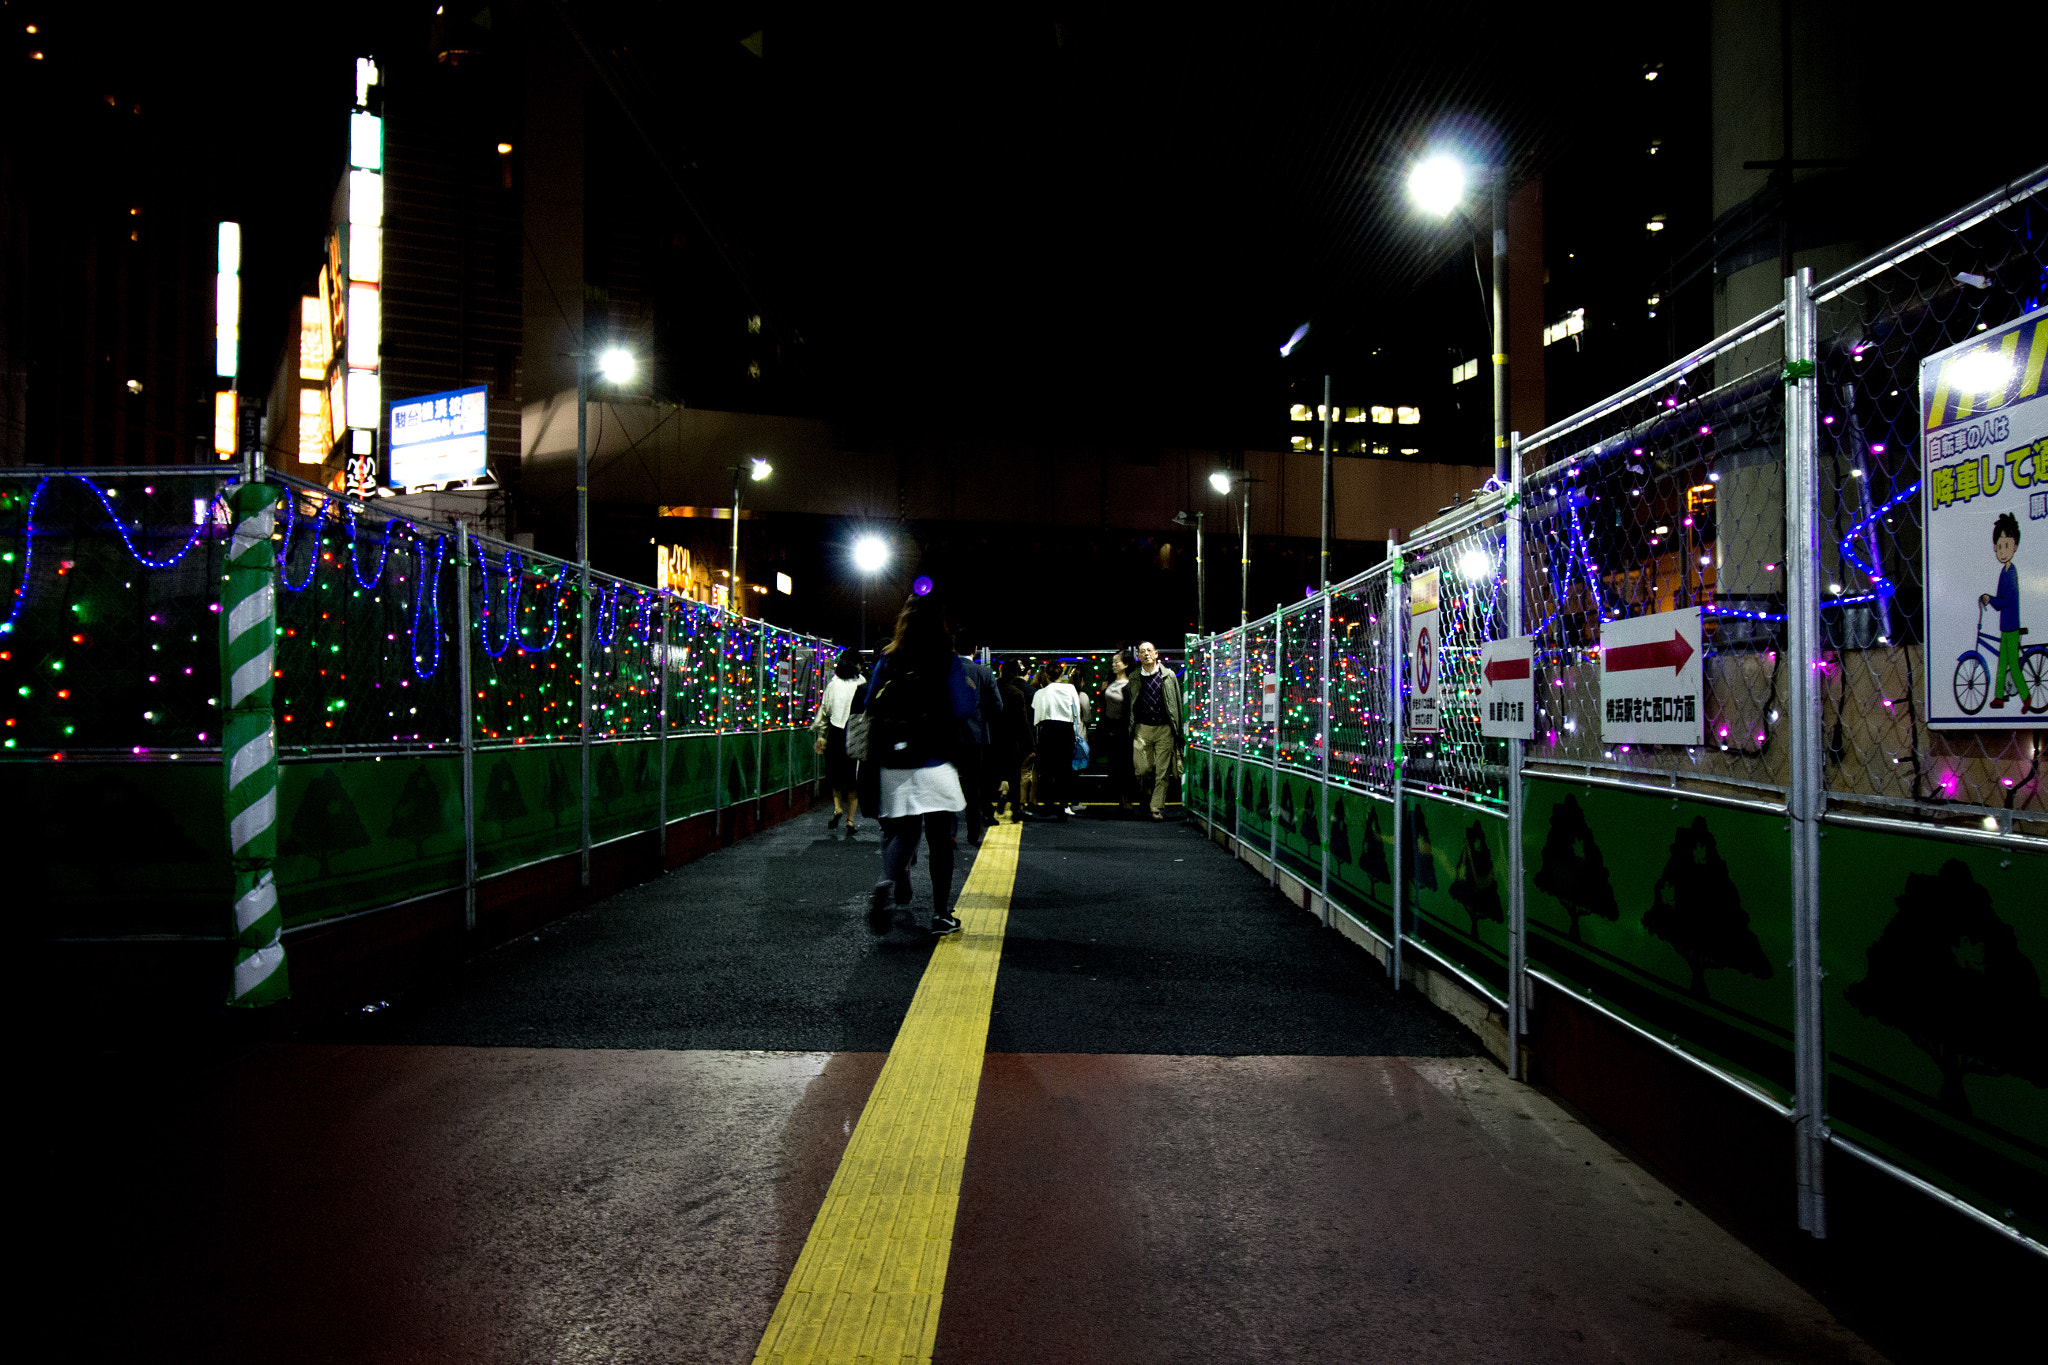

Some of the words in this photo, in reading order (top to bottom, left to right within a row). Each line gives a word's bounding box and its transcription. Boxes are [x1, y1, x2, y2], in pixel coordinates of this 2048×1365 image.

[1929, 416, 2009, 463] 自転車の人は
[1932, 436, 2048, 511] 降車して通
[1606, 695, 1696, 723] 横浜駅きた西口方面
